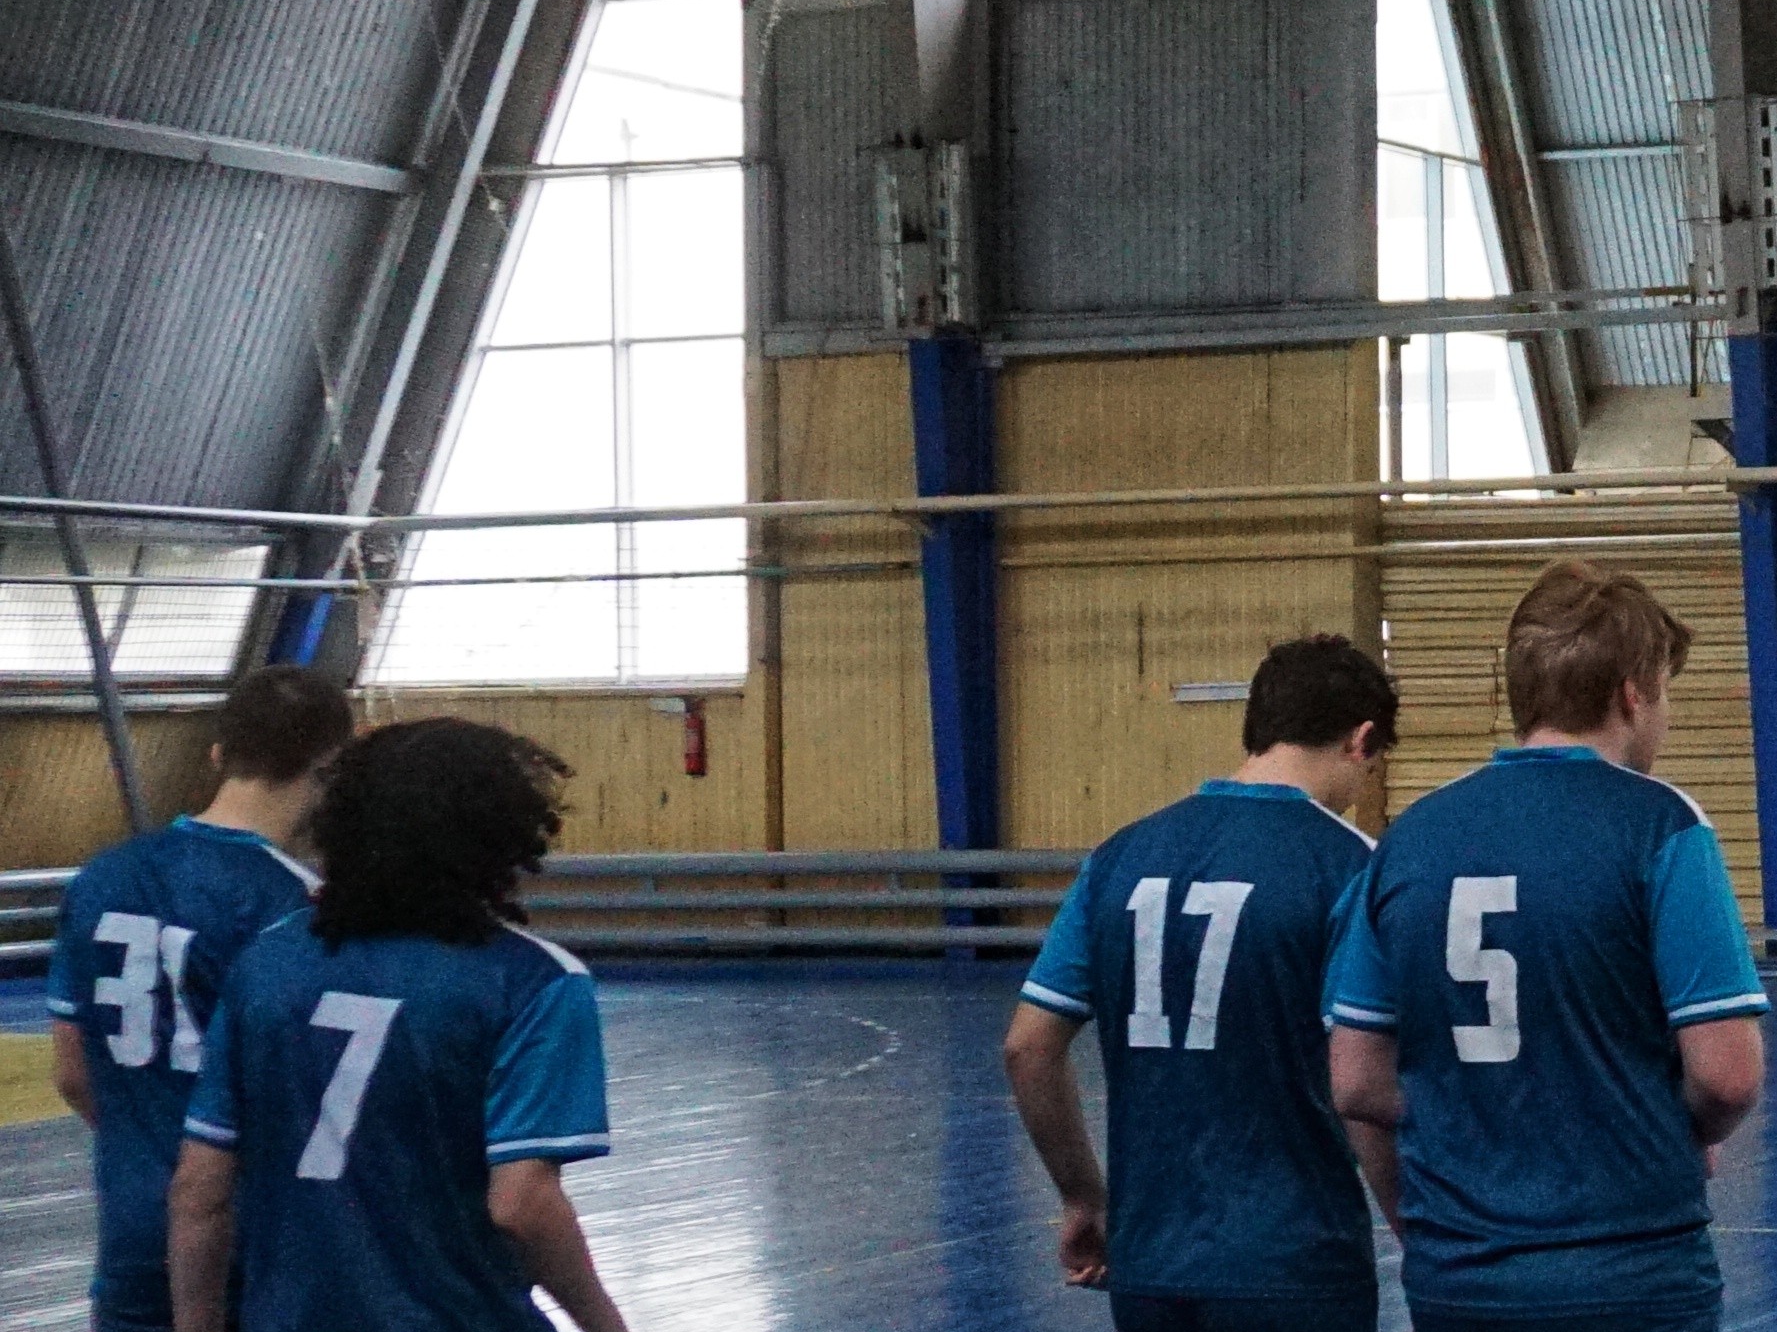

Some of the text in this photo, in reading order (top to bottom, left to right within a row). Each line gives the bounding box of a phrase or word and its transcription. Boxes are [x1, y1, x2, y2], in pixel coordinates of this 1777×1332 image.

[1126, 877, 1254, 1050] 17
[1445, 875, 1520, 1063] 5
[297, 991, 401, 1179] 7
